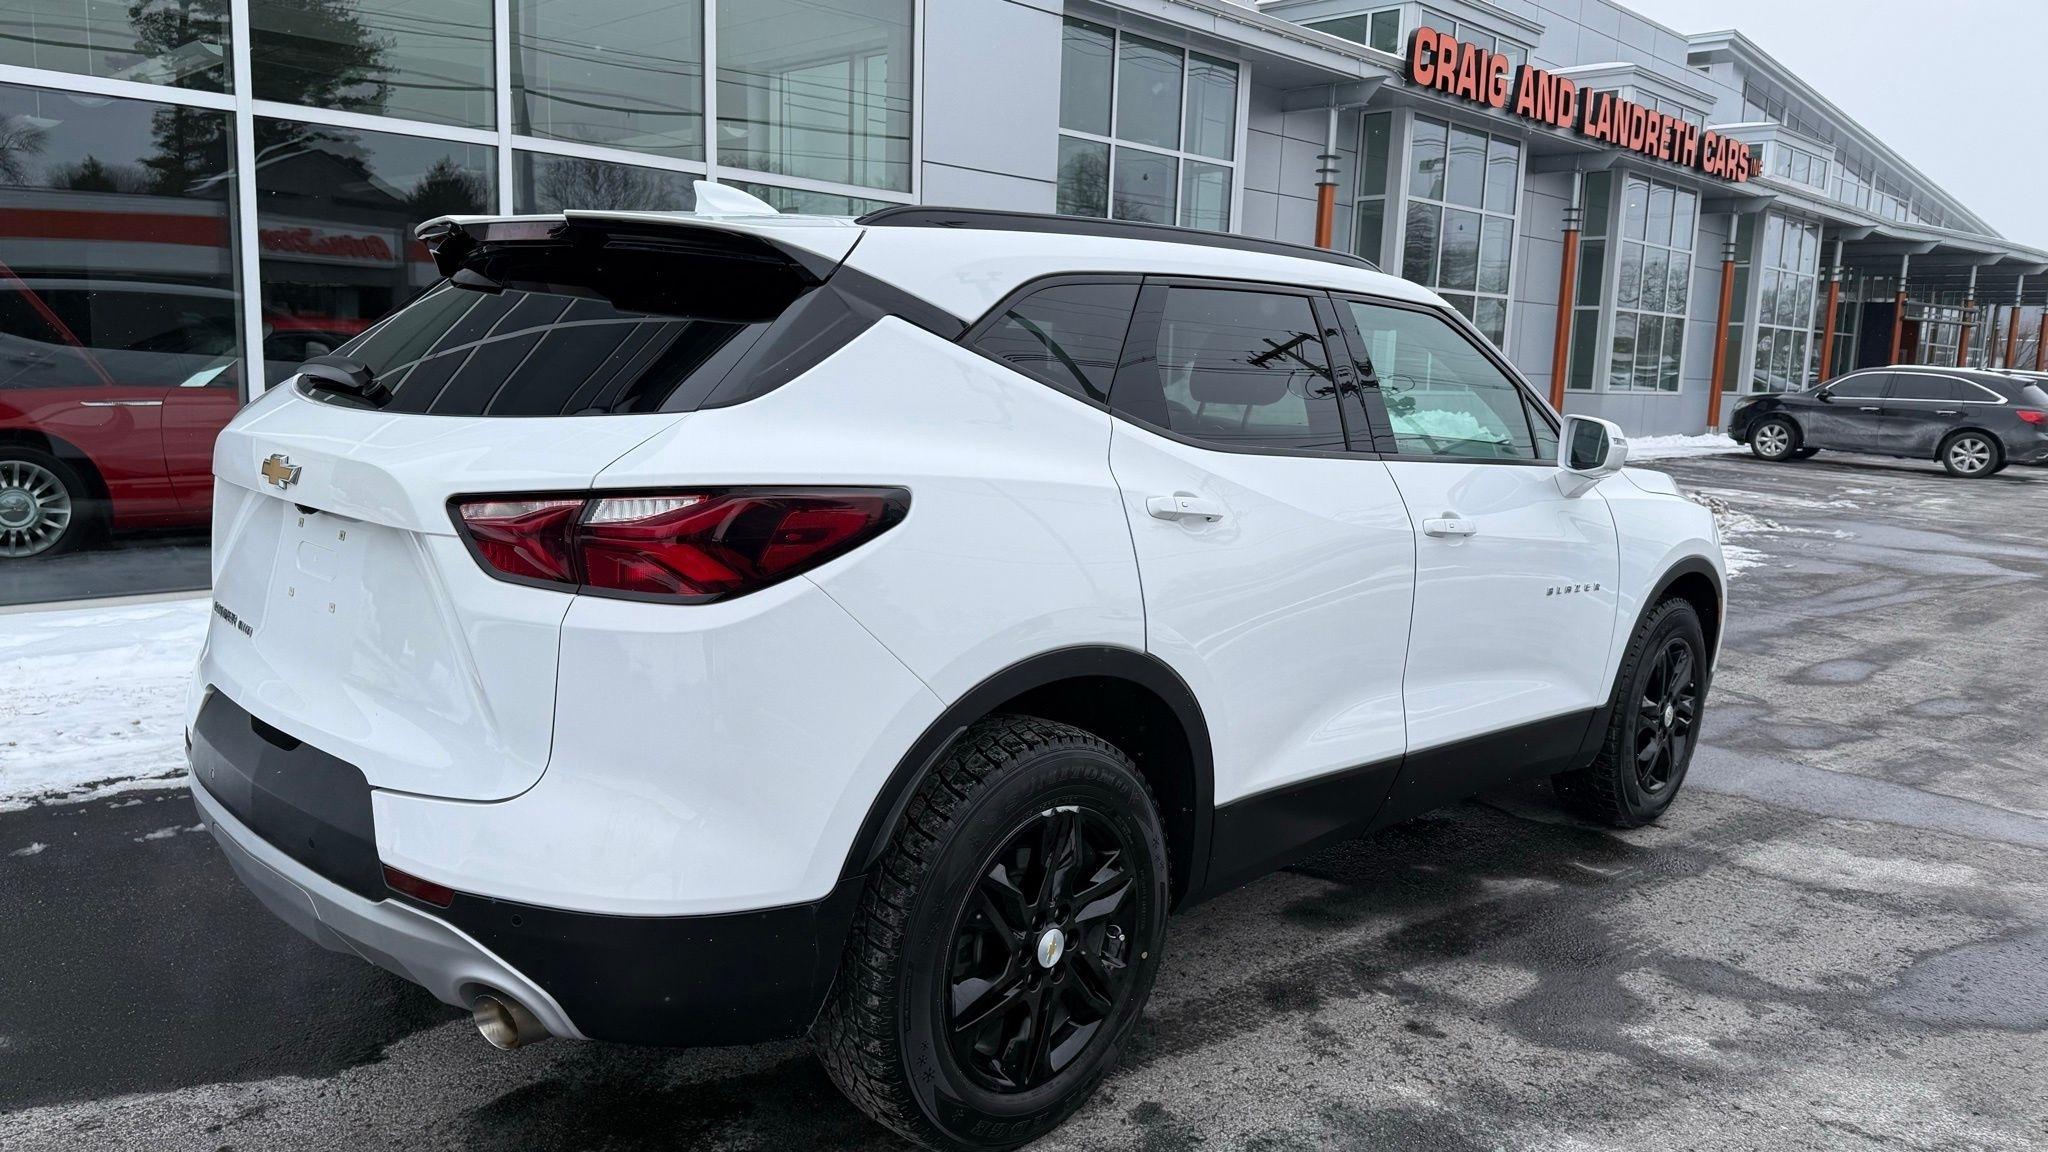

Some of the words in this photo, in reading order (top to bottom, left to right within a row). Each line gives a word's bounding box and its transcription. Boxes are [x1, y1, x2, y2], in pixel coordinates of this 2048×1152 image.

[1411, 26, 1509, 108] CRAIG
[1515, 63, 1577, 128] AND
[1583, 87, 1699, 167] LANDRETH
[1702, 129, 1750, 183] CARS
[1546, 582, 1601, 596] BLAZER
